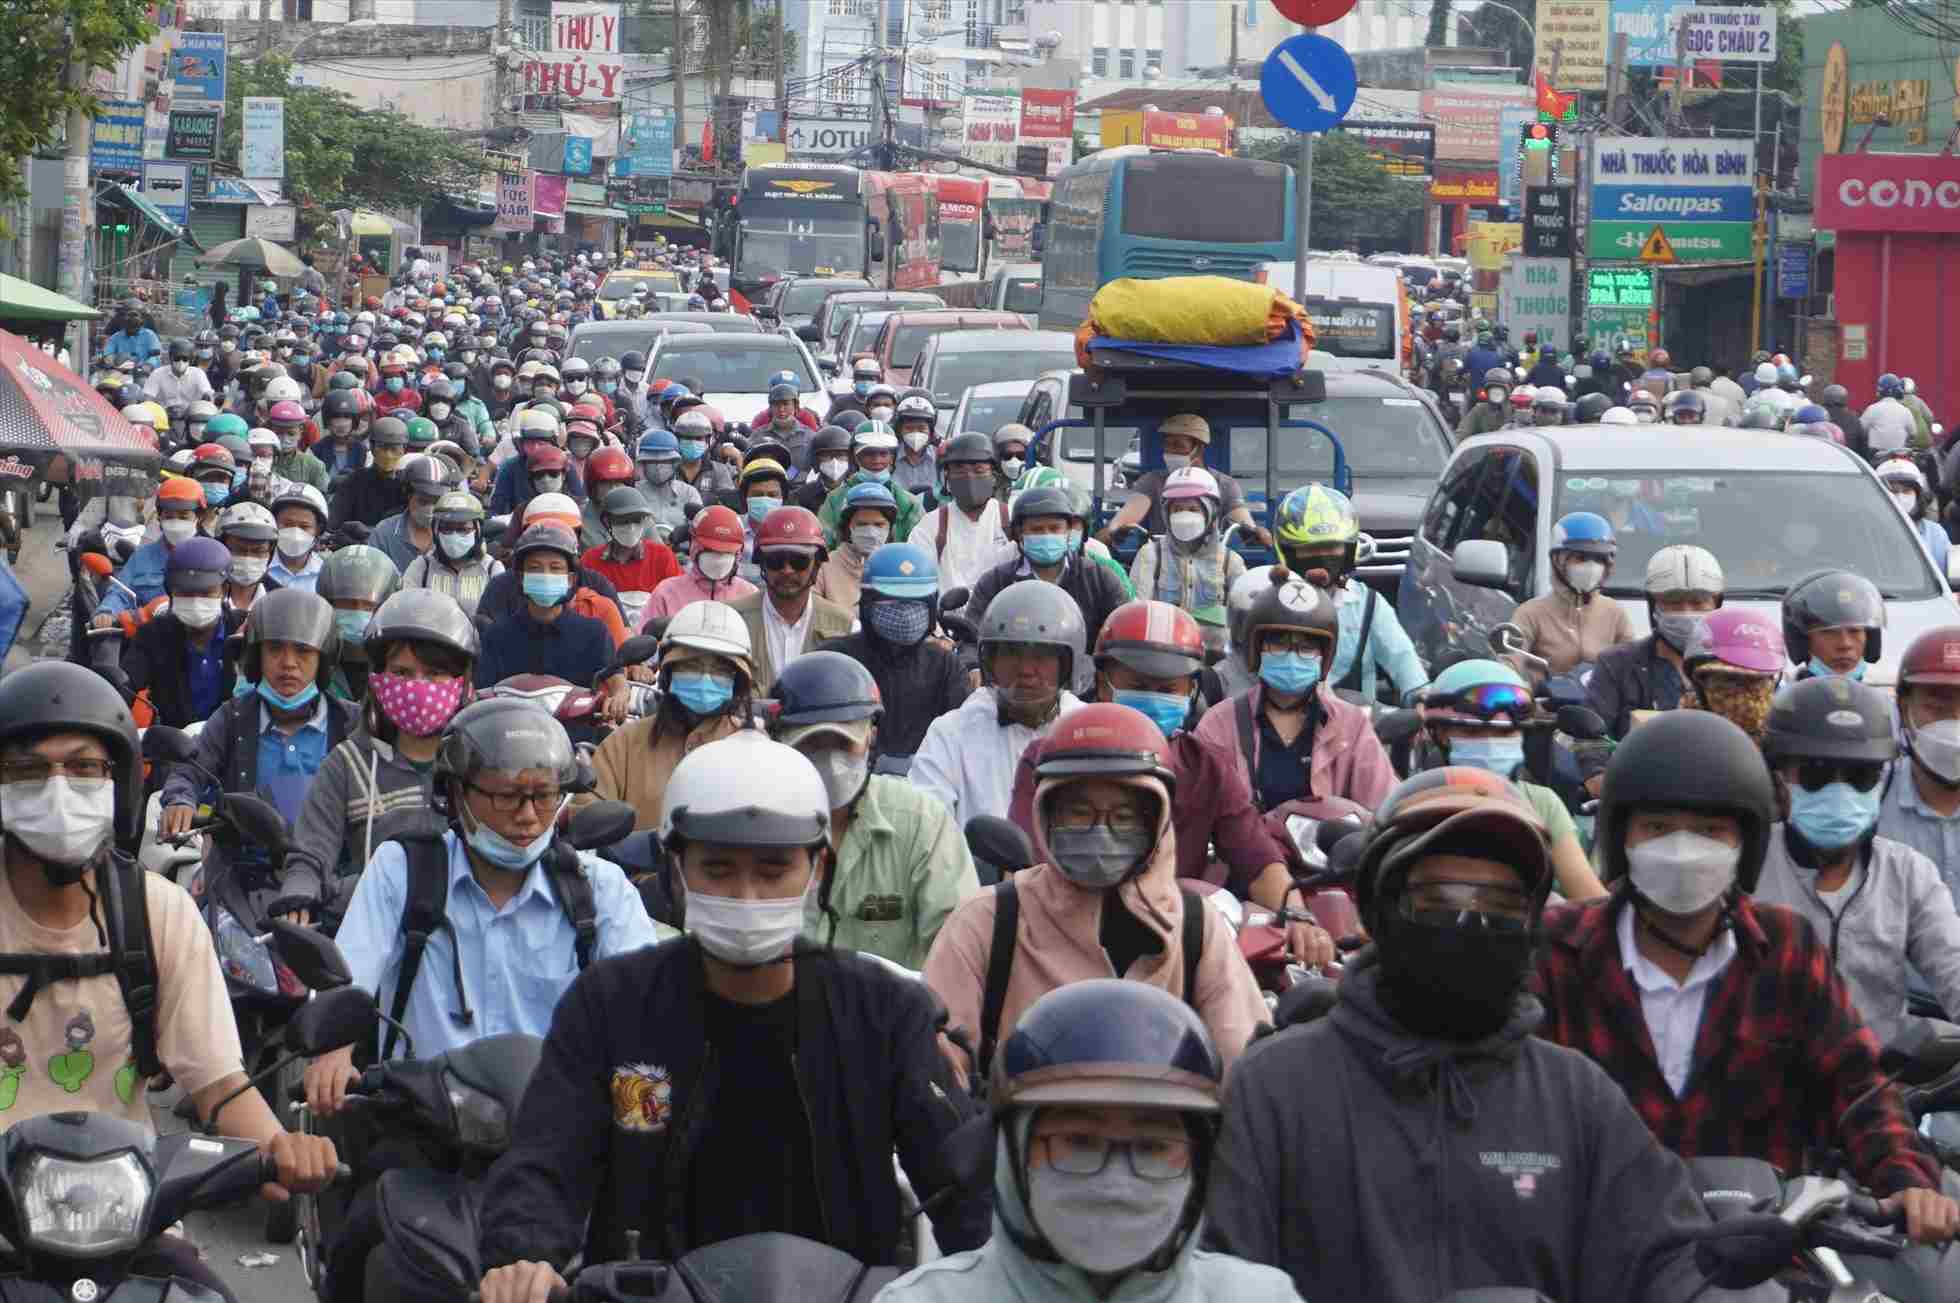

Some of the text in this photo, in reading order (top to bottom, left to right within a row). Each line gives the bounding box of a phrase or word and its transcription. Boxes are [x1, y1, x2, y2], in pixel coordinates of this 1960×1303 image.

[1758, 30, 1771, 53] 2
[174, 117, 215, 135] KARAOKE
[1600, 146, 1747, 174] NHÀ THUỐC HÒA BÌNH
[1618, 192, 1723, 216] Salonpas
[1533, 210, 1565, 228] THUỐC
[1592, 270, 1650, 287] NHÀ THUỐC
